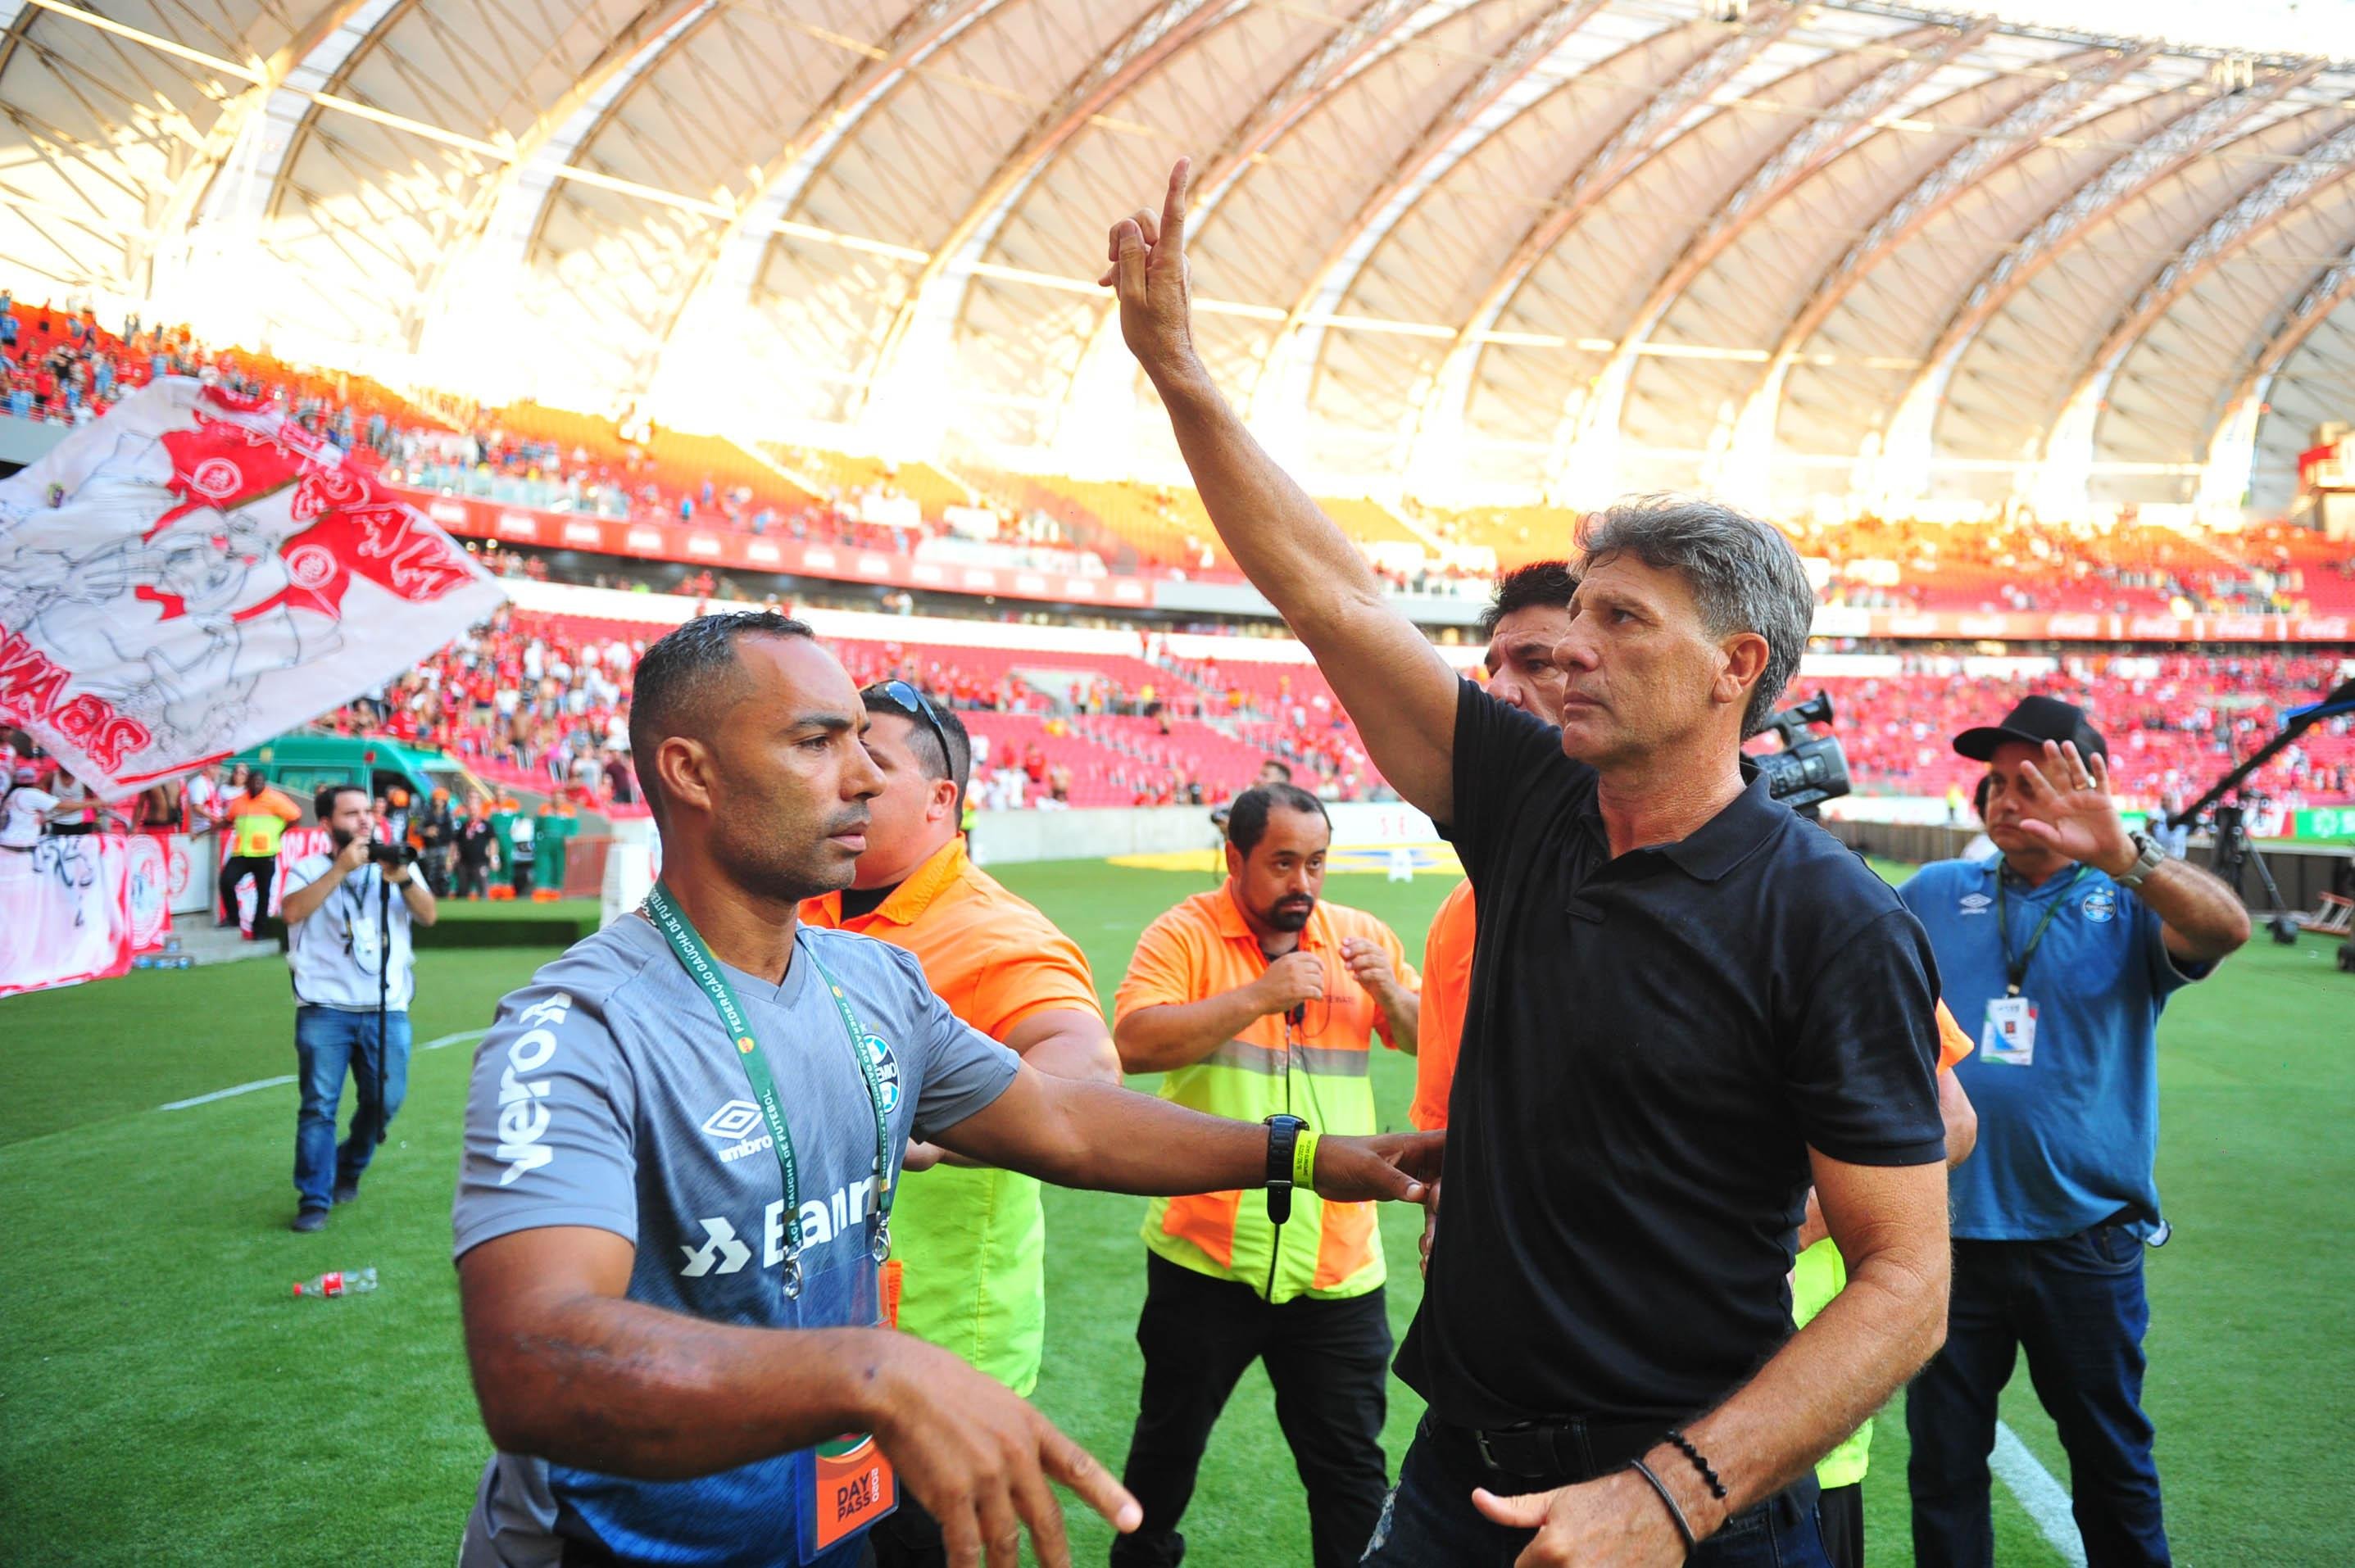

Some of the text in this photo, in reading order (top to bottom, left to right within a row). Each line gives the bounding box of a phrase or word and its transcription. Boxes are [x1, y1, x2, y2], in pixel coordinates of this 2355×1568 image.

[665, 918, 681, 933] DE
[674, 931, 709, 972] GAÚCHA
[701, 972, 745, 1033] FEDERAÇÃO
[763, 1089, 787, 1143] FUTEBOL
[878, 1108, 887, 1125] DE
[718, 1134, 774, 1162] umbro
[781, 1142, 792, 1159] DE
[837, 1471, 870, 1506] DAY
[837, 1491, 870, 1522] PASS
